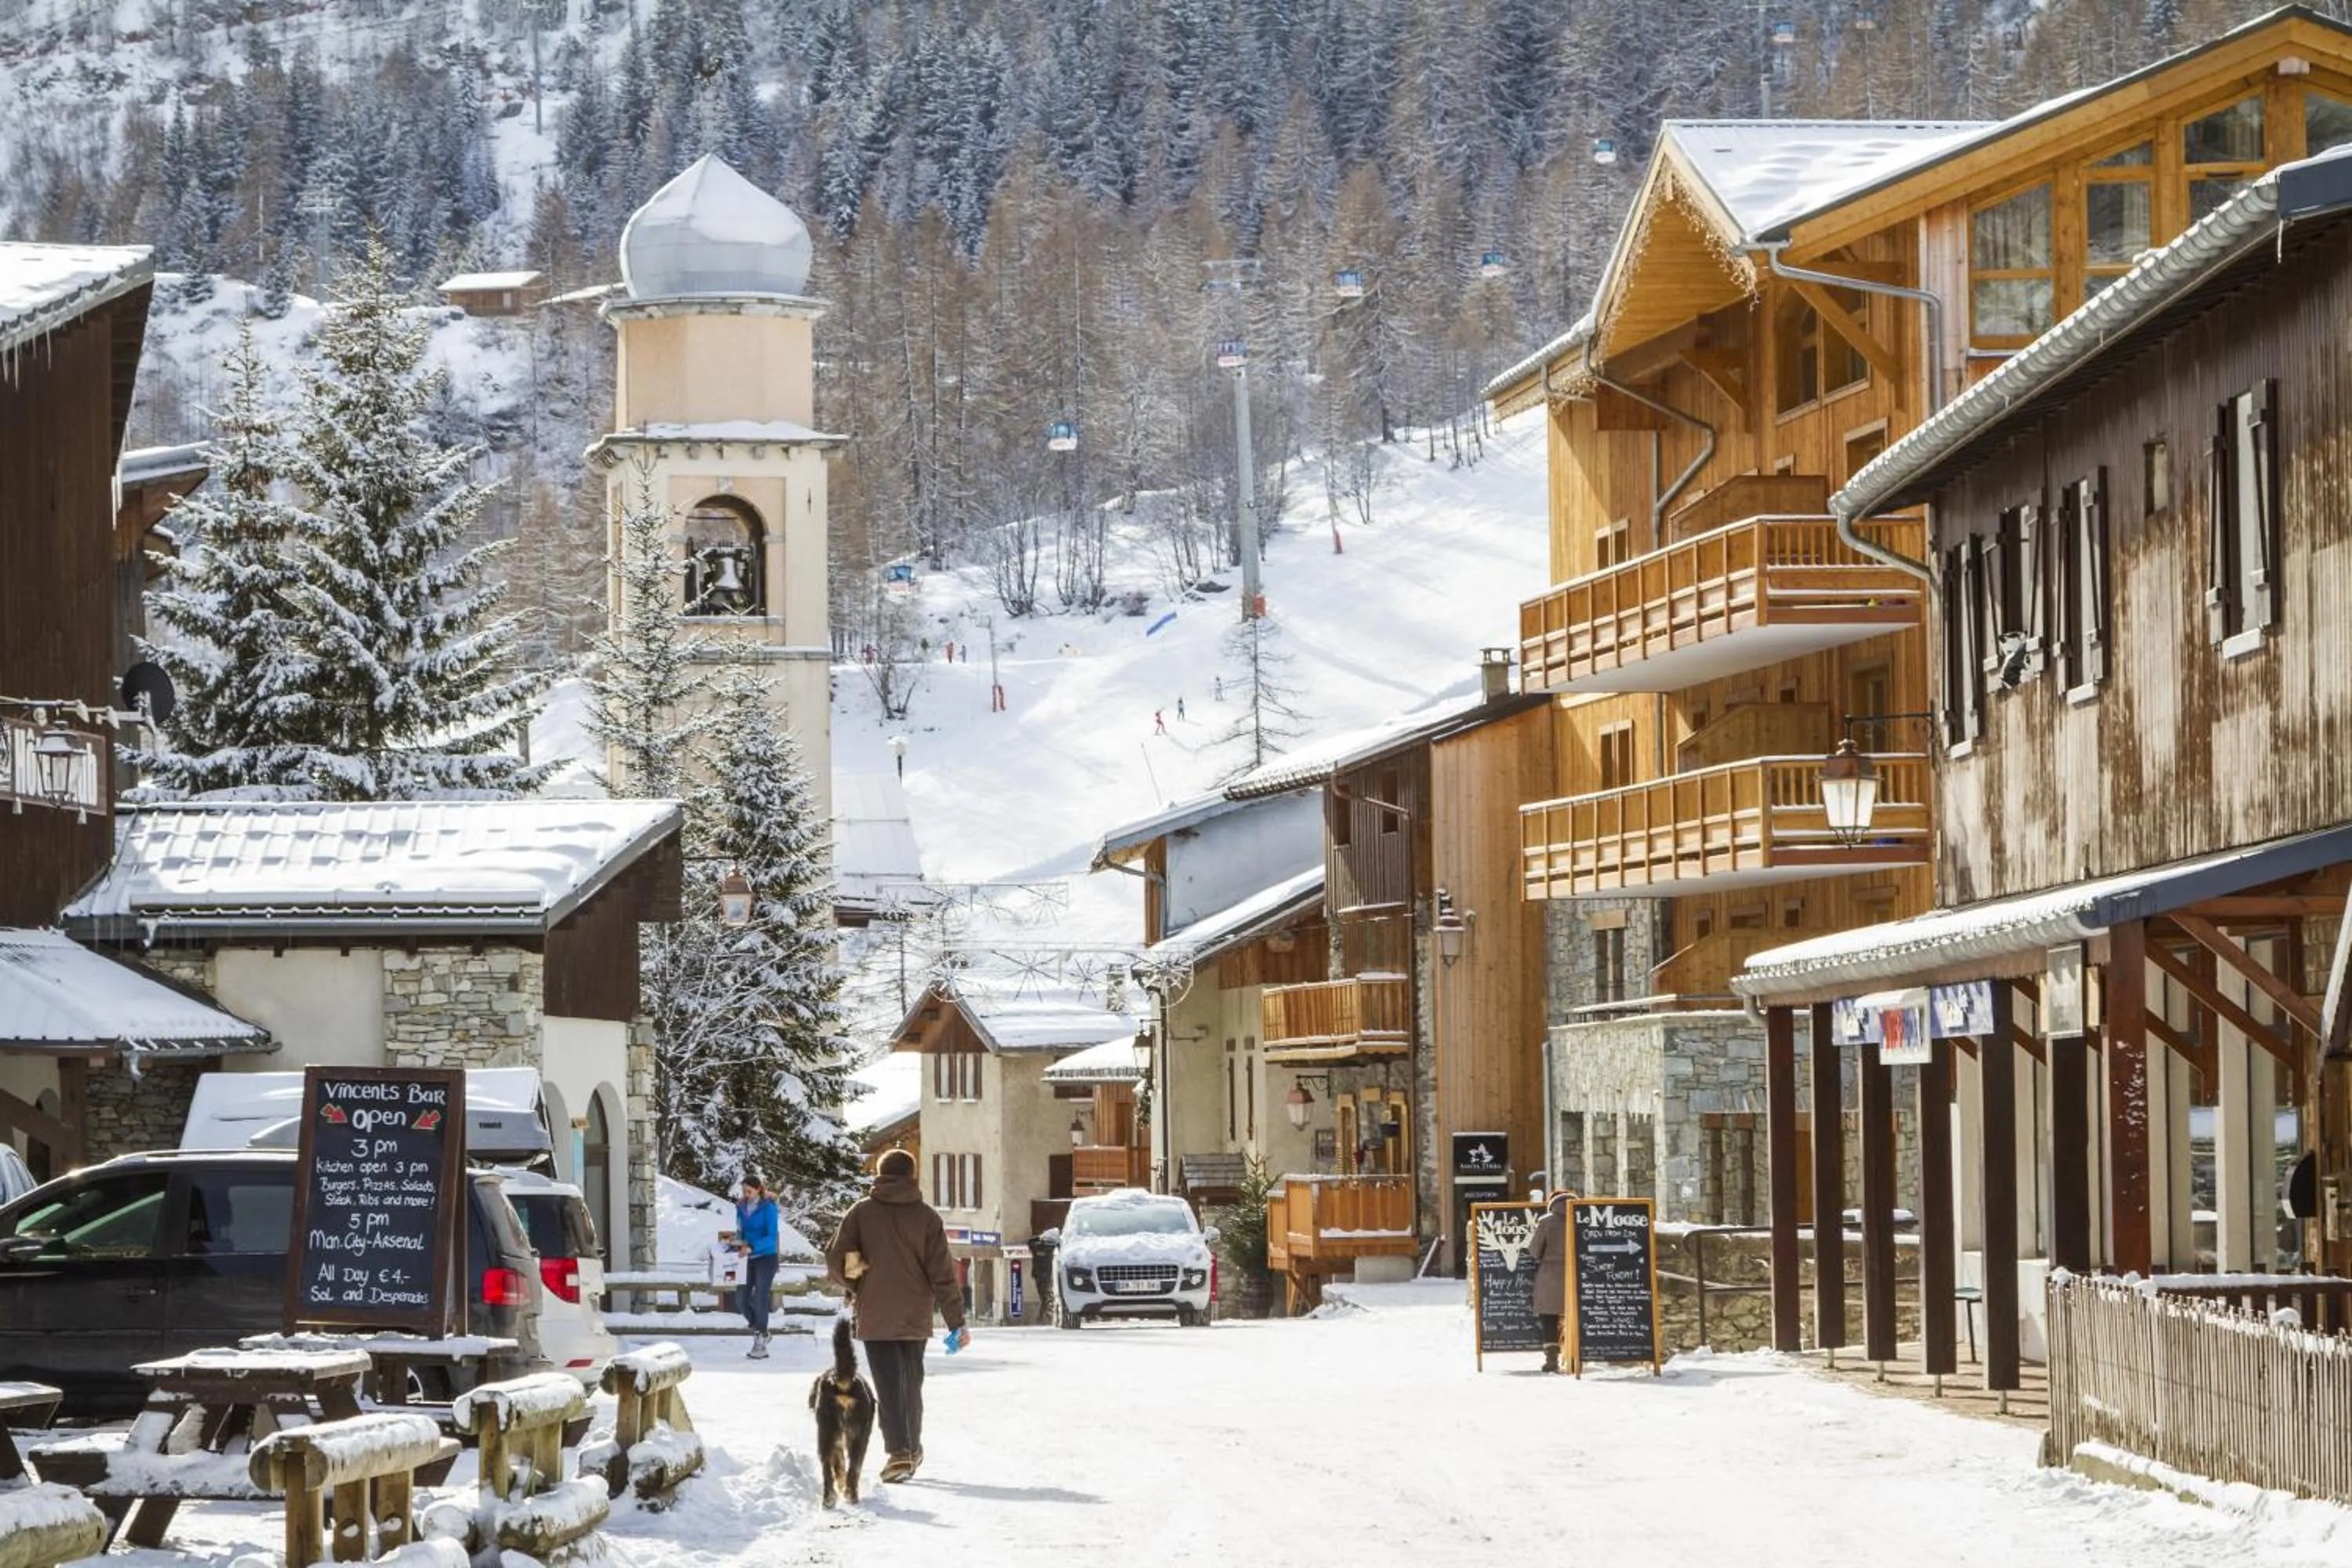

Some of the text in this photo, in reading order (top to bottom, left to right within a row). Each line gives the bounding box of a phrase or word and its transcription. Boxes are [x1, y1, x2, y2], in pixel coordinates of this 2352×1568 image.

[325, 1082, 400, 1101] Vincents
[351, 1138, 397, 1159] 3 pm
[359, 1162, 388, 1175] open
[395, 1161, 404, 1173] 3
[408, 1162, 429, 1178] pm
[383, 1195, 402, 1204] and
[348, 1214, 389, 1233] 5 pm
[1503, 1211, 1519, 1225] Le
[1576, 1205, 1648, 1229] Le Moose
[318, 1262, 335, 1281] All
[343, 1268, 369, 1287] Day
[343, 1289, 363, 1300] and
